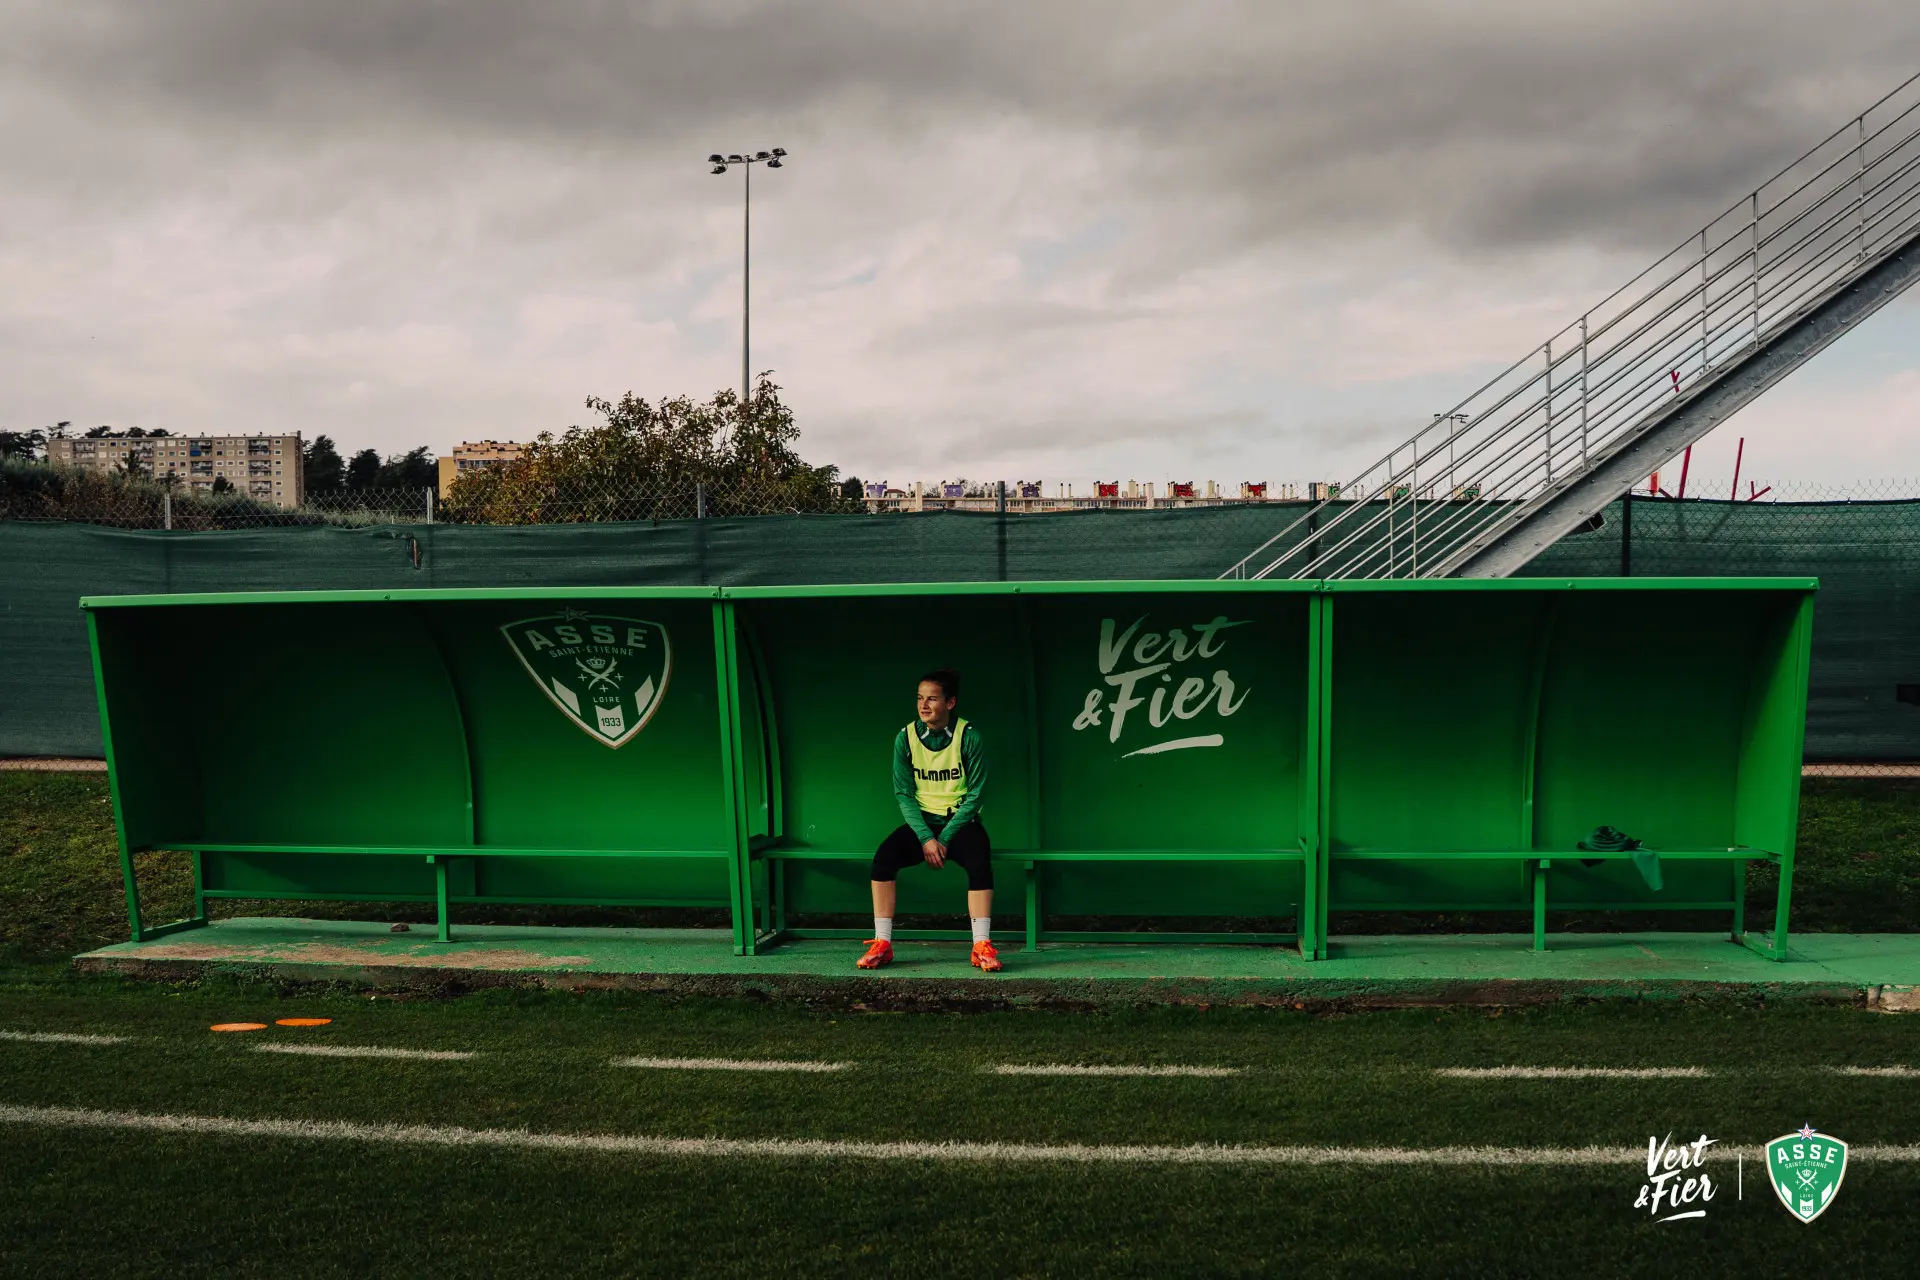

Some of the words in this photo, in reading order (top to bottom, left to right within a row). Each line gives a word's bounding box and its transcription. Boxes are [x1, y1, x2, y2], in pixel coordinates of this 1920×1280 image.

[524, 625, 648, 651] ASSE
[1099, 612, 1257, 674] Vert
[549, 645, 634, 658] SAINT-ÉTIENNE
[601, 718, 622, 727] 1933
